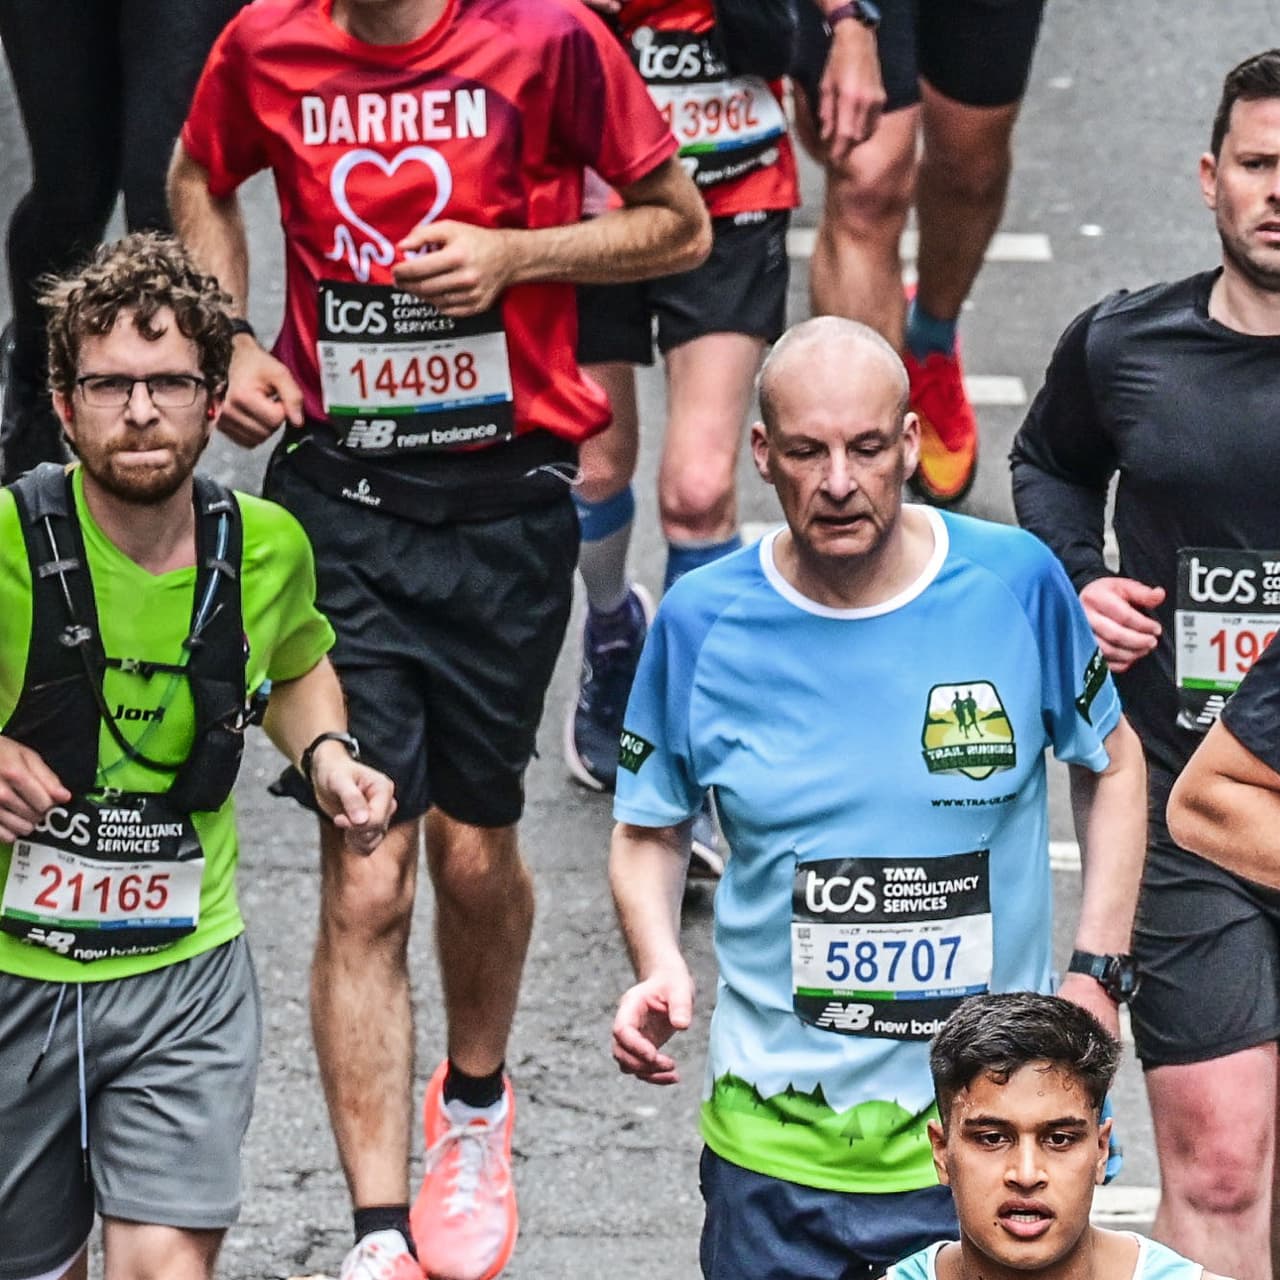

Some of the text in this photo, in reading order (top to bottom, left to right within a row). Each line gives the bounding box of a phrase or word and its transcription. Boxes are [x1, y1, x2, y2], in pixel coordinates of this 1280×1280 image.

[301, 89, 487, 145] DARREN
[325, 290, 387, 335] tcs
[394, 320, 455, 334] SERVICES
[351, 352, 478, 399] 14498
[397, 435, 430, 447] new
[432, 423, 498, 444] balance
[1189, 557, 1257, 604] tcs
[928, 746, 964, 760] TRAIL
[98, 809, 141, 822] TATA
[37, 807, 91, 846] cs
[97, 823, 183, 838] CONSULTANCY
[97, 839, 160, 853] SERVICES
[883, 867, 927, 881] TATA
[34, 863, 170, 914] 21165
[805, 870, 876, 913] tcs
[883, 876, 979, 897] CONSULTANCY
[883, 897, 948, 913] SERVICES
[73, 948, 108, 960] new
[825, 935, 962, 984] 58707
[874, 1019, 908, 1034] new
